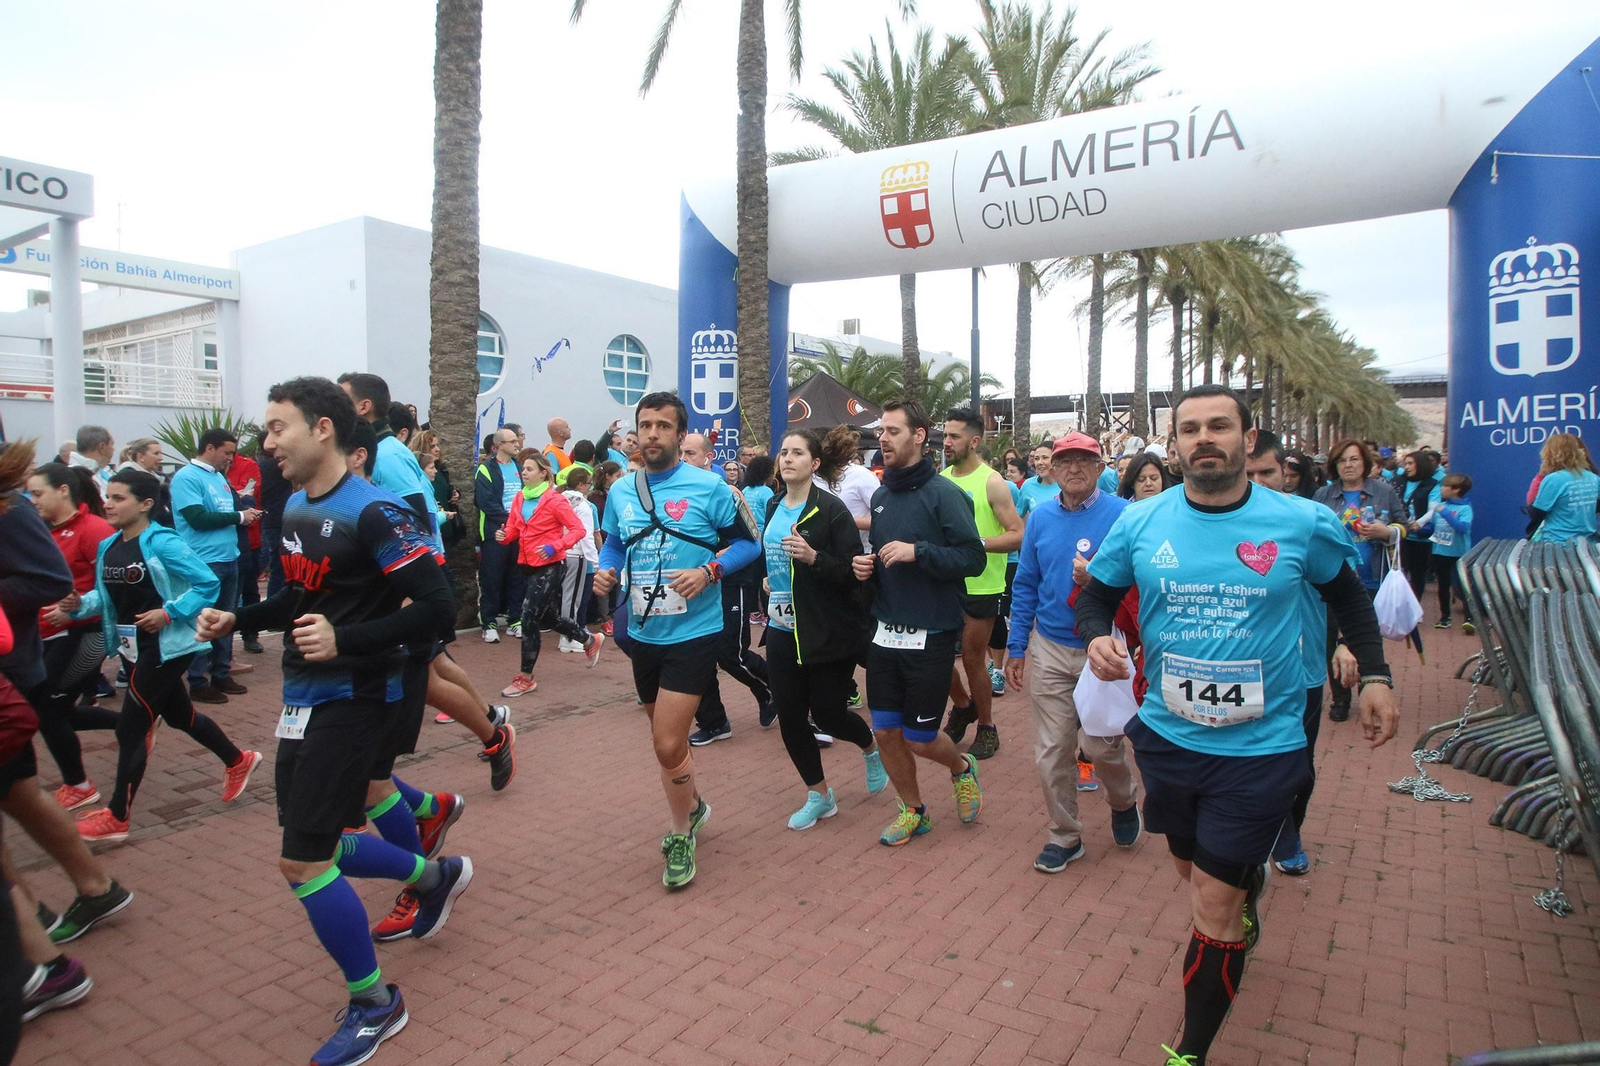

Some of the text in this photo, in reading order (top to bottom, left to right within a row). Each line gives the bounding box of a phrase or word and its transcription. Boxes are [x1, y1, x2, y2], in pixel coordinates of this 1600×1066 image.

[979, 106, 1246, 193] ALMERÍA
[0, 167, 68, 200] ICO
[981, 187, 1108, 230] CIUDAD
[116, 261, 157, 278] Bahía
[162, 269, 233, 290] Almeriport
[1460, 385, 1600, 429] ALMERÍ
[1150, 555, 1179, 564] ALTEA
[642, 585, 667, 601] 54
[1169, 580, 1215, 593] Runner
[1219, 583, 1267, 597] Fashion
[1167, 594, 1247, 608] Carrera azul
[1167, 605, 1250, 620] por el autismo
[1181, 626, 1209, 641] nada
[1179, 679, 1245, 707] 144
[1193, 704, 1228, 716] POR ELLOS
